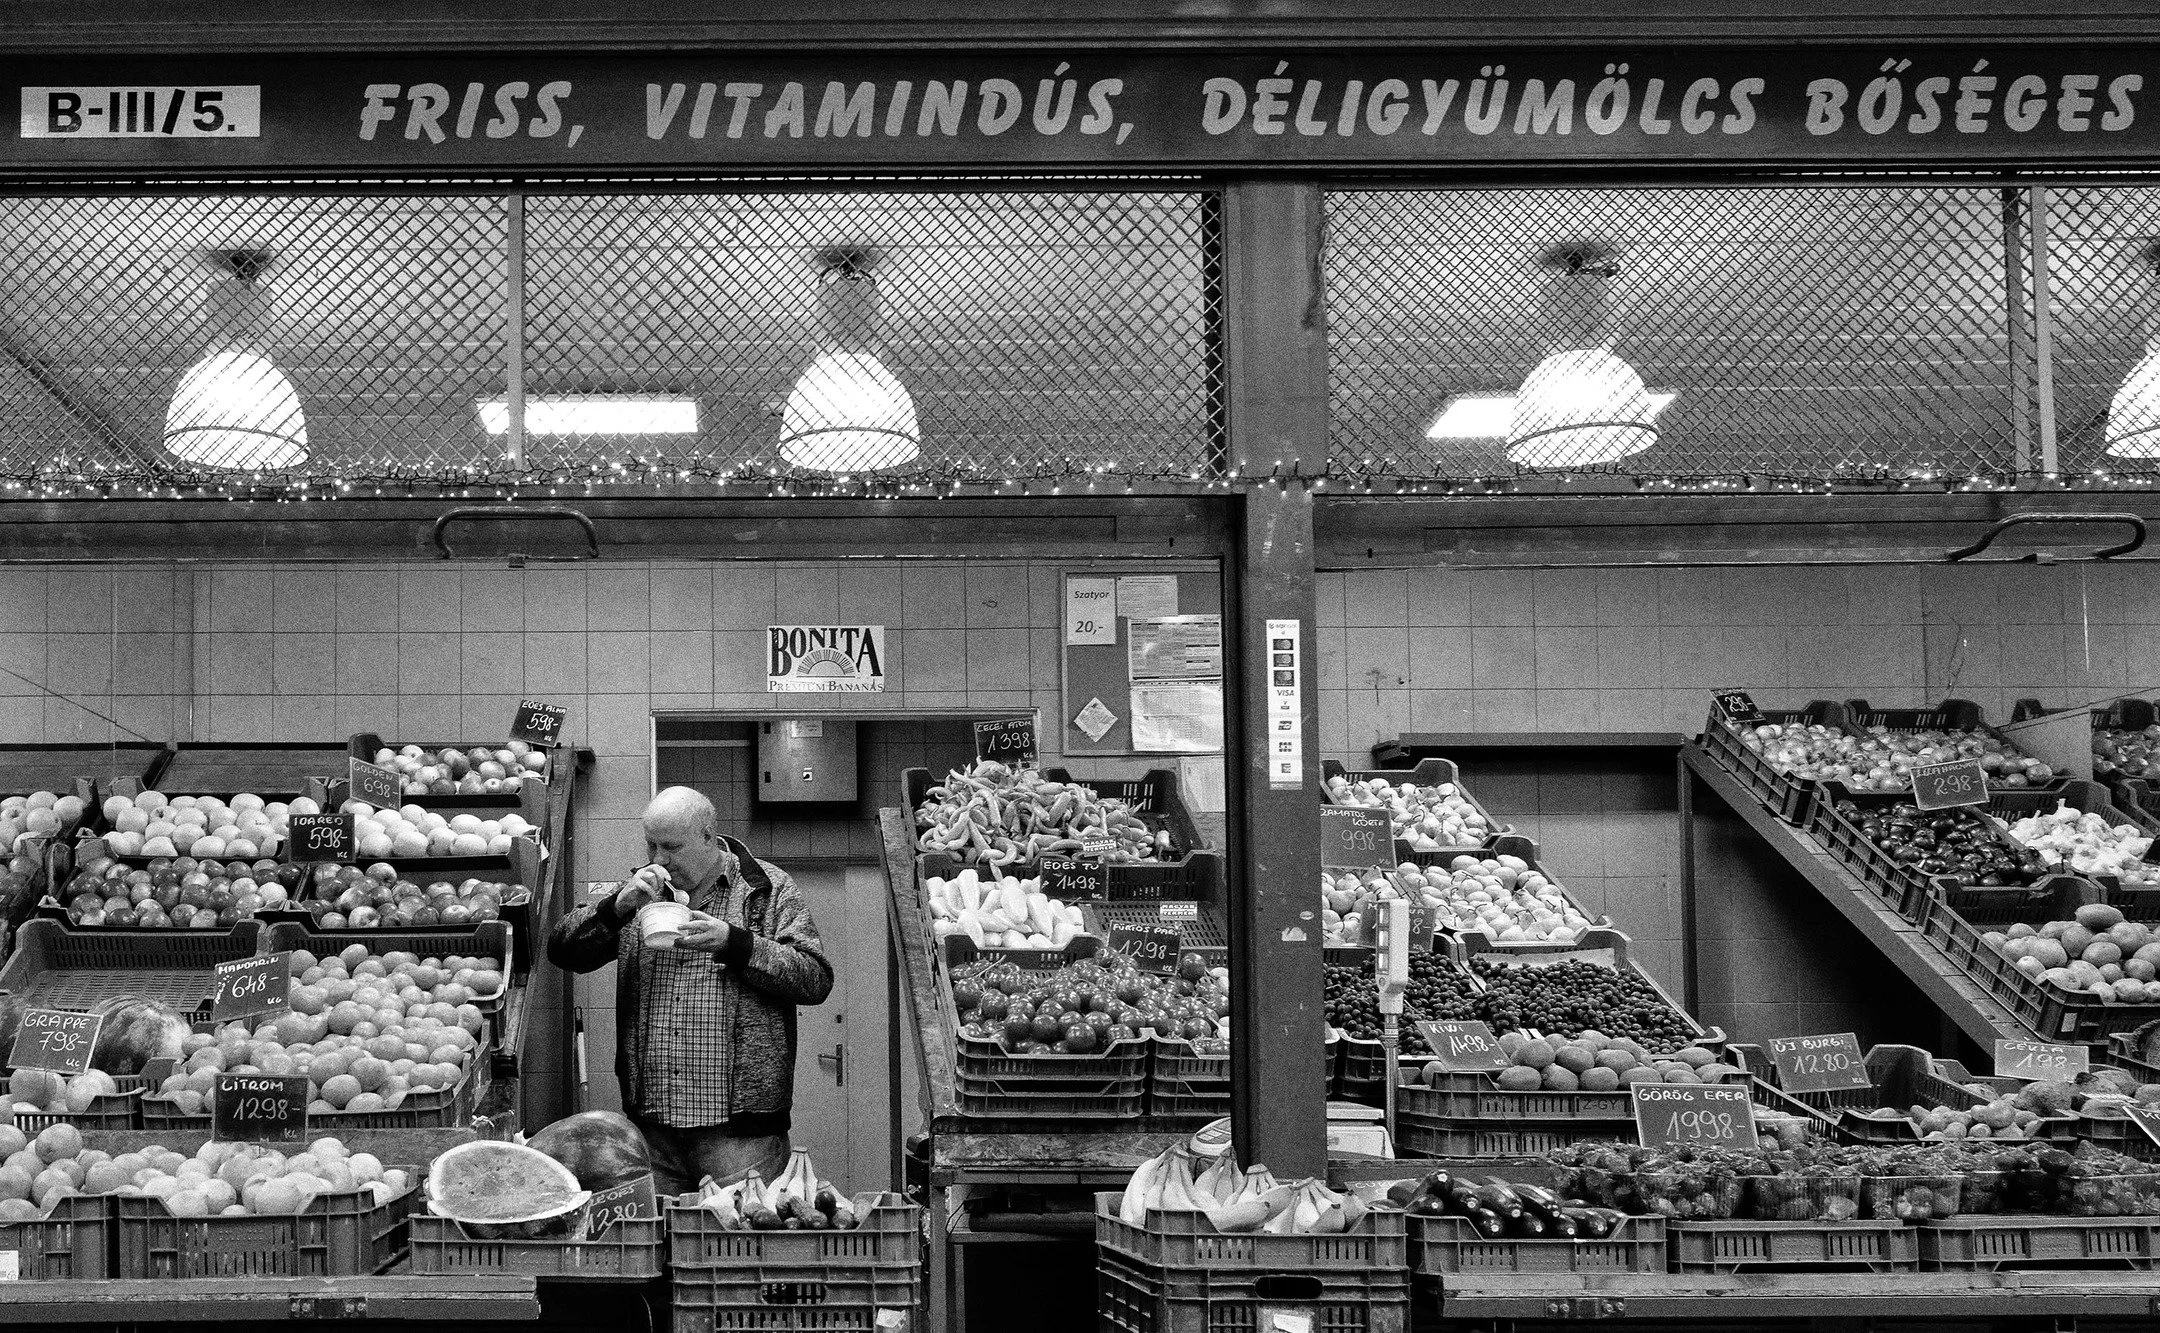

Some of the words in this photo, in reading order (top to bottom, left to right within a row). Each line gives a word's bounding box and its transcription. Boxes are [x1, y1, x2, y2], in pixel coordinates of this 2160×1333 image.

[47, 89, 236, 135] B-III/5.
[358, 80, 585, 149] FRISS,
[645, 61, 1135, 146] VITAMINDÚS,
[1200, 59, 1766, 137] DÉLIGYÜMÖLCS
[1804, 57, 2144, 136] BŐSÉGES
[1074, 590, 1110, 600] Szatyor
[1075, 620, 1104, 636] 20,-
[768, 627, 884, 677] BONITA
[828, 678, 886, 692] BANANAS
[526, 712, 559, 732] 598-
[363, 776, 399, 798] 698-
[1933, 774, 1980, 796] 298-
[307, 826, 349, 850] 598-
[1341, 829, 1386, 851] 998-
[1118, 939, 1178, 960] 1298-
[231, 972, 280, 999] 648-
[24, 1011, 91, 1030] GRAPPE
[38, 1031, 89, 1052] 798-
[1793, 1053, 1860, 1075] 1280-
[1703, 1090, 1746, 1101] EPER
[232, 1097, 301, 1121] 1298-
[1666, 1110, 1746, 1140] 1998-
